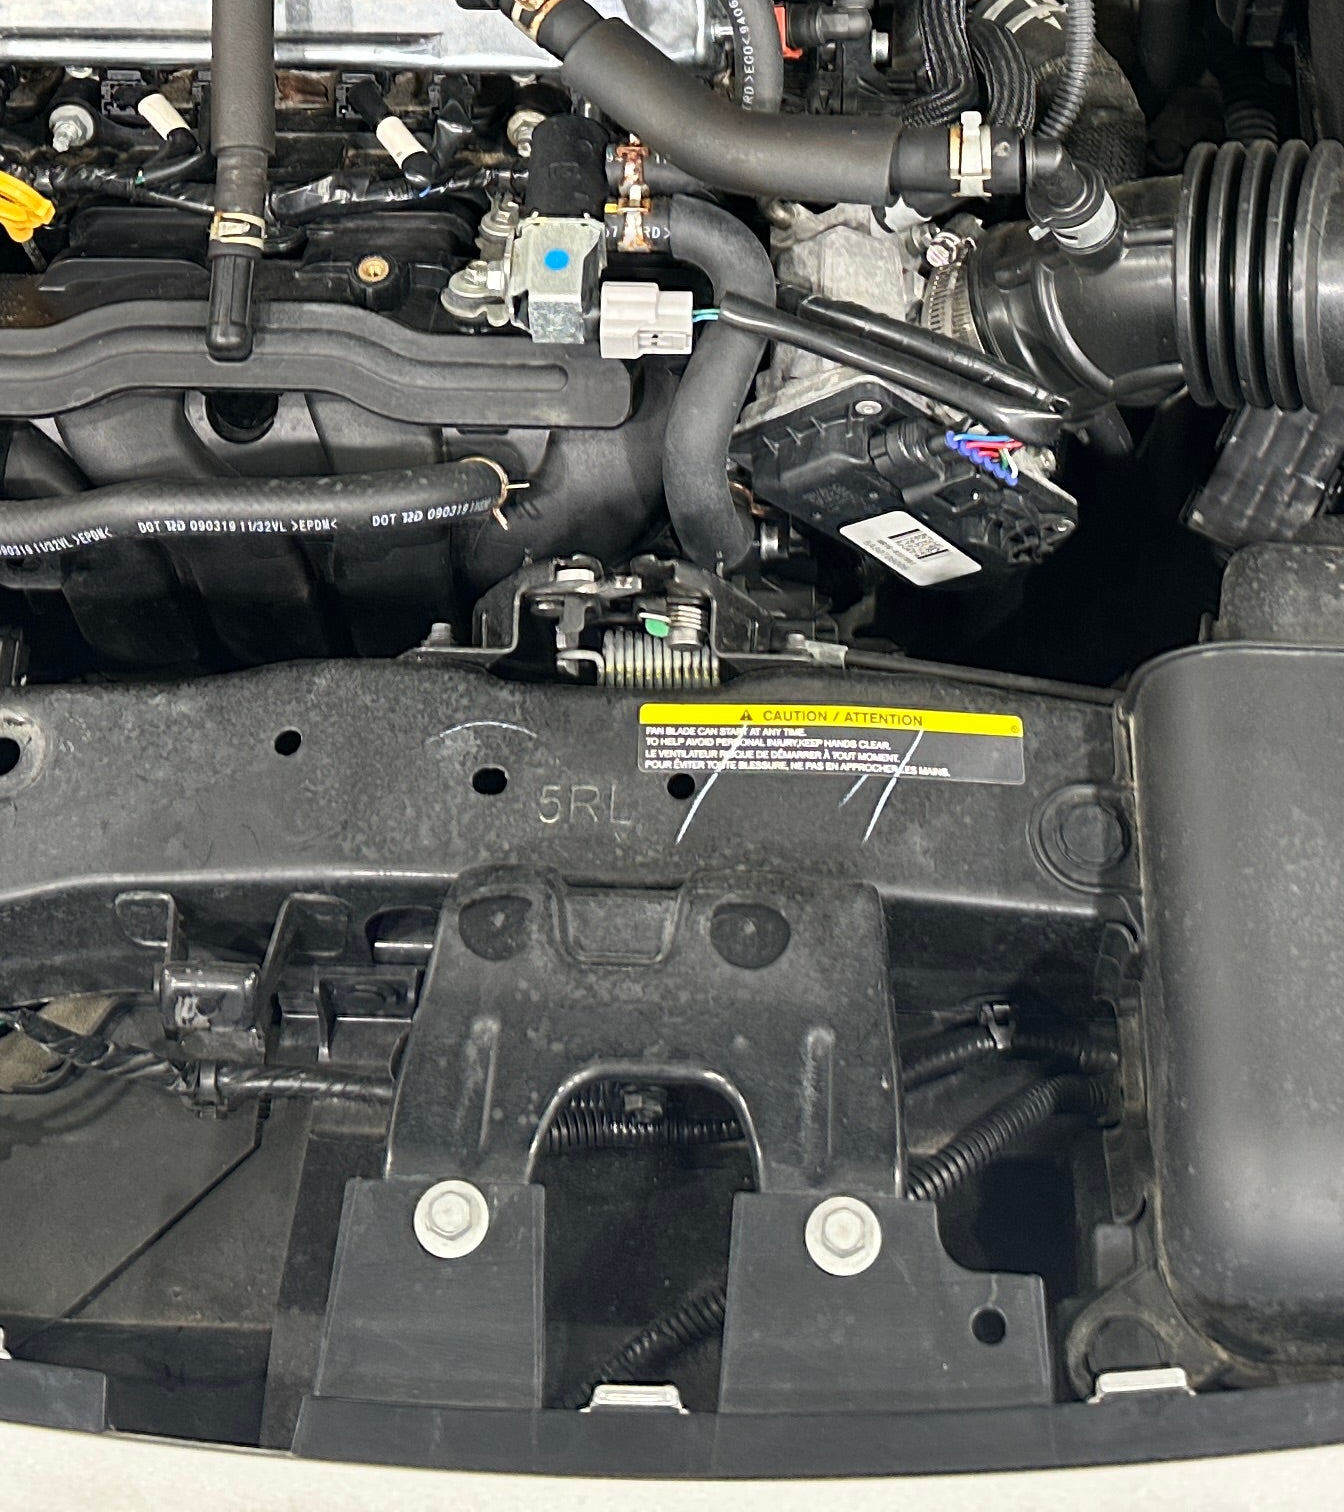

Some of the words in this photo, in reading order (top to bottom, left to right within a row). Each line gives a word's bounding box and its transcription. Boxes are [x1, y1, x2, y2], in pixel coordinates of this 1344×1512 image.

[372, 513, 397, 527] DOT
[427, 503, 470, 521] 090319
[137, 519, 161, 534] DOT
[189, 520, 236, 533] 090319
[762, 710, 828, 722] CAUTION
[844, 711, 923, 727] ATTENTION
[645, 727, 665, 736] FAN
[665, 727, 696, 736] BLADE
[697, 727, 719, 736] CAN
[747, 727, 761, 736] AT
[762, 727, 783, 736] ANY
[783, 727, 807, 737] TIME.
[645, 738, 659, 746] TO
[660, 738, 684, 746] HELP
[685, 738, 714, 747] AVOID
[824, 739, 858, 749] HANDS
[858, 740, 892, 751] CLEAR.
[645, 749, 657, 758] LE
[658, 749, 719, 759] VENTILATEUR
[758, 750, 770, 759] DE
[771, 748, 822, 760] DÉMARRER
[832, 751, 858, 761] TOUT
[858, 752, 901, 763] MOMENT.
[644, 760, 672, 769] POUR
[674, 758, 705, 769] ÉVITER
[738, 761, 789, 771] BLESSURE,
[790, 762, 805, 770] NE
[806, 762, 825, 771] PAS
[826, 763, 840, 772] EN
[840, 763, 899, 774] APPROCHER
[537, 784, 632, 824] 5RL
